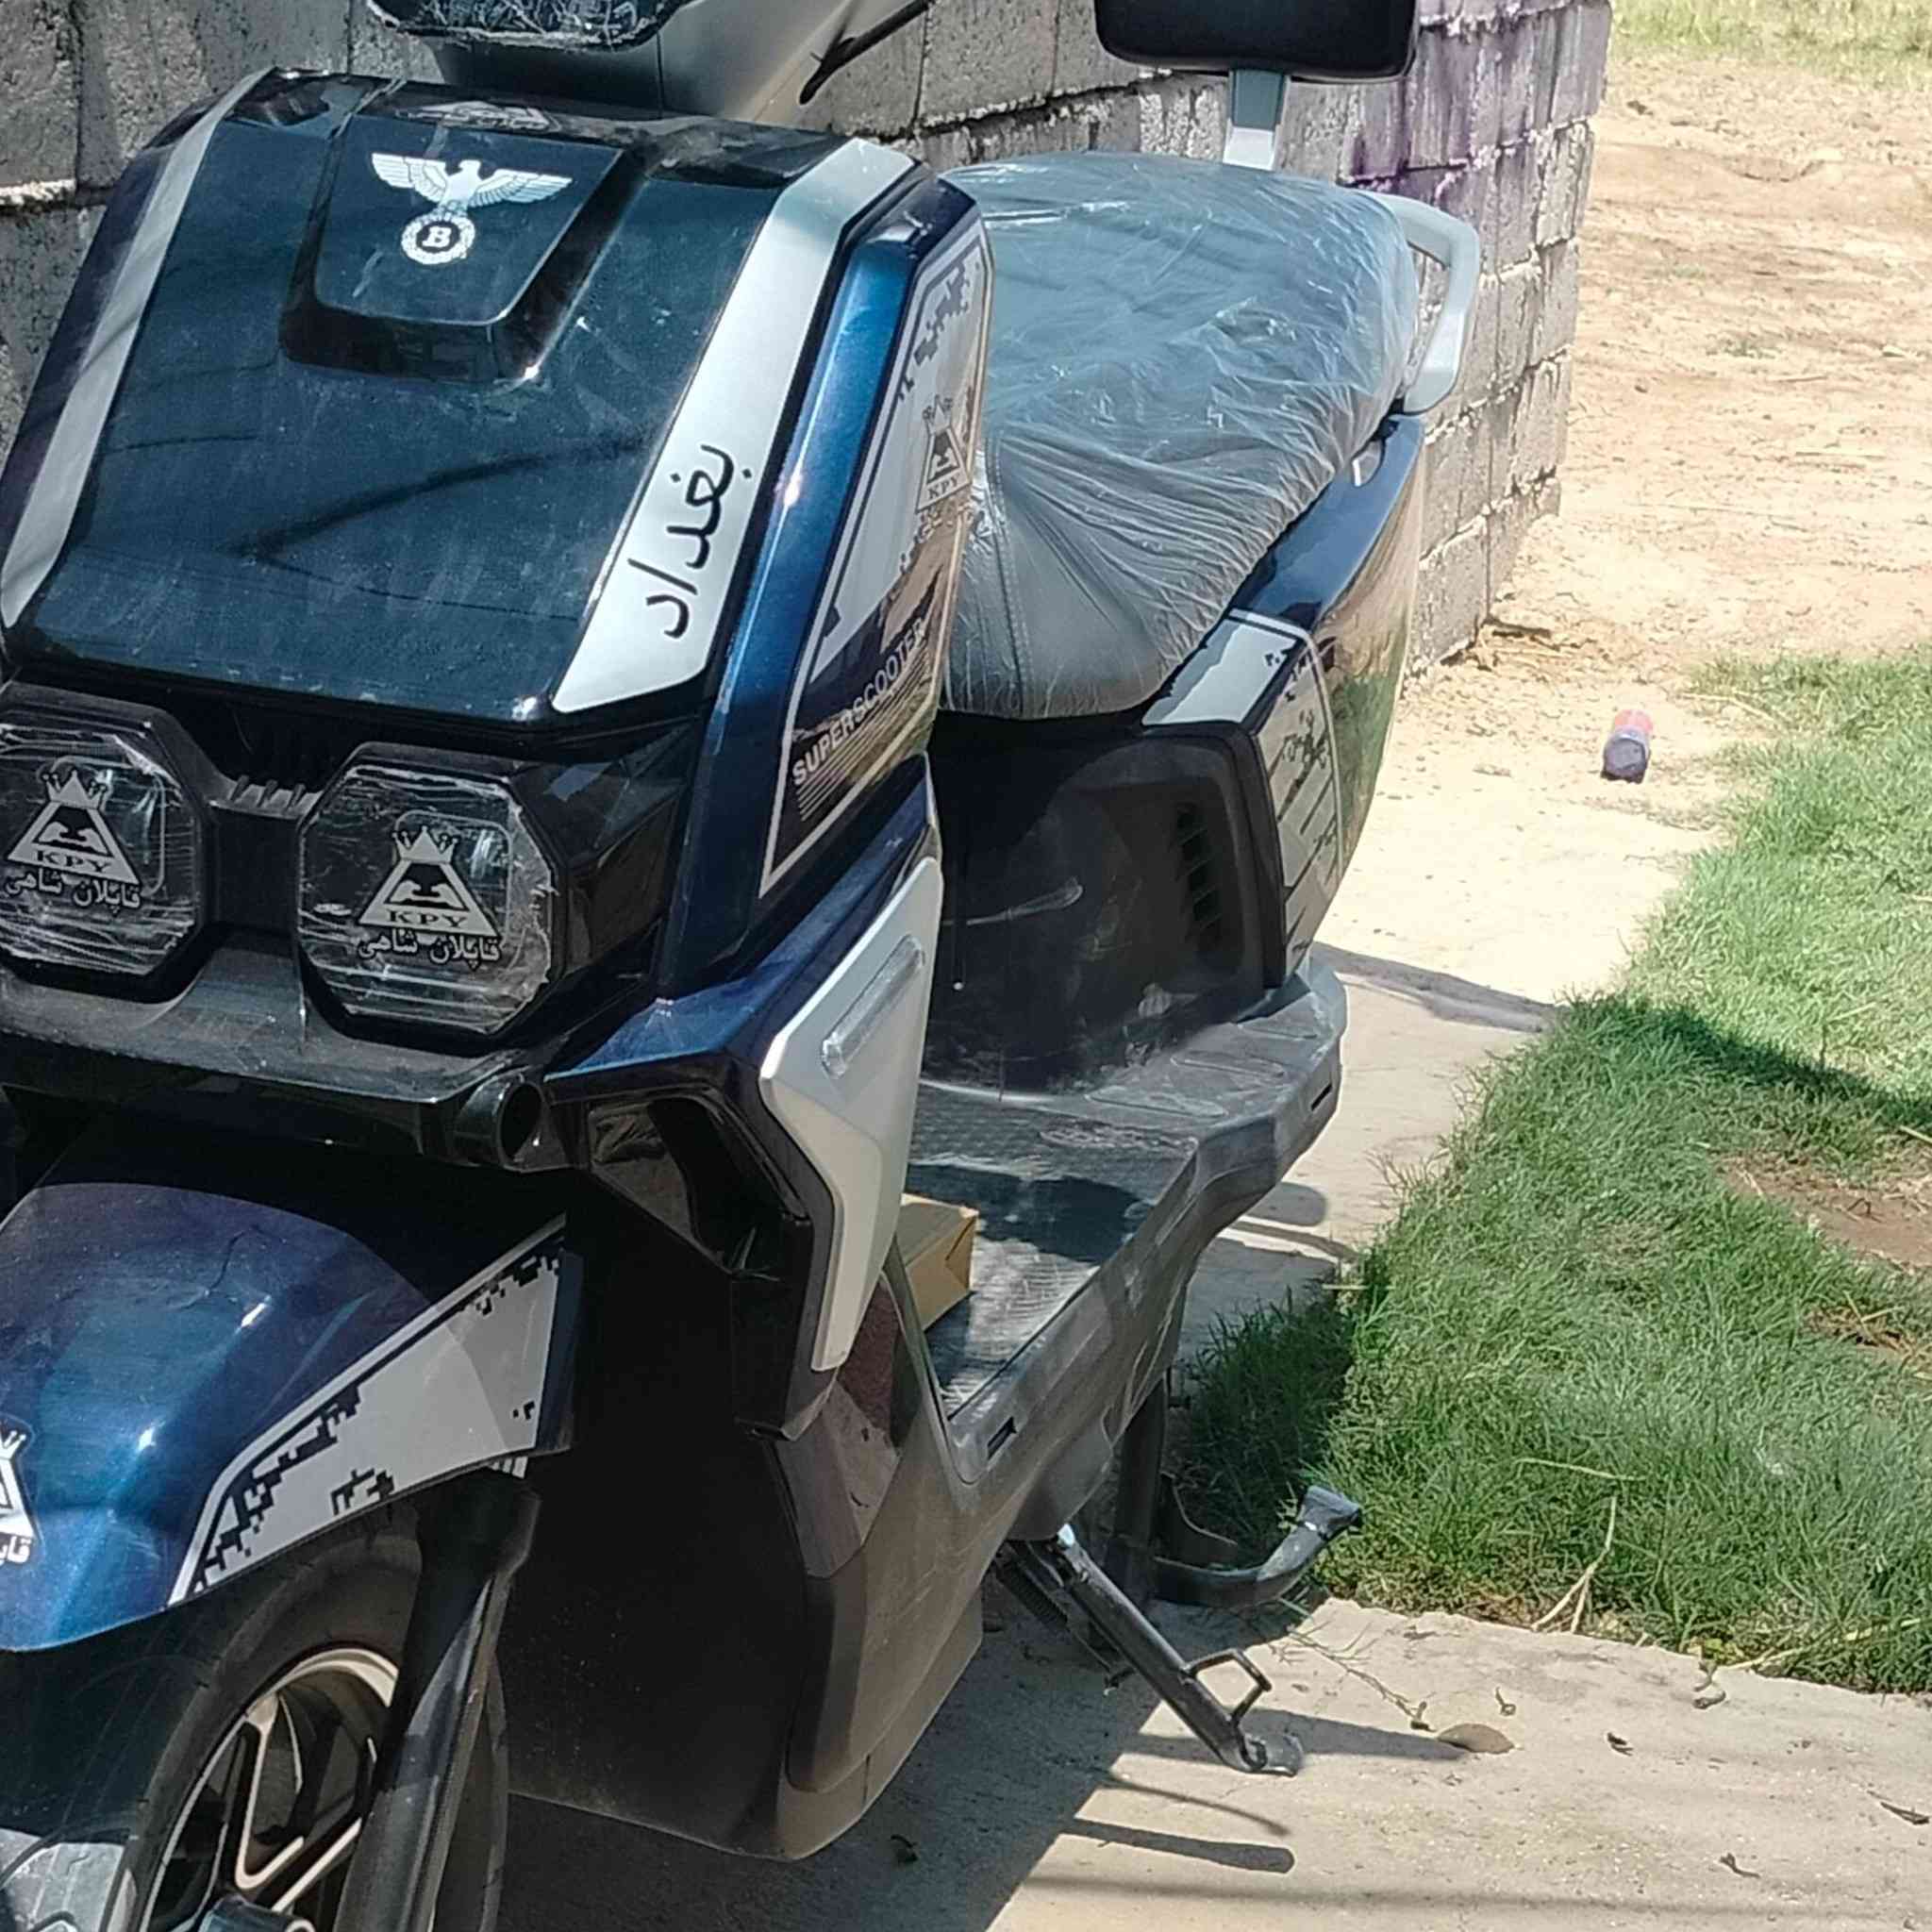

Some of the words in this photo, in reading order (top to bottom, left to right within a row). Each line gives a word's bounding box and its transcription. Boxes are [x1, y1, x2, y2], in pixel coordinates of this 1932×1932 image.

[422, 225, 453, 249] B
[928, 476, 958, 500] KPY
[627, 443, 752, 639] بغداد
[792, 618, 927, 786] SUPERSCOOTER
[36, 850, 111, 873] KPY
[387, 908, 468, 928] KPY
